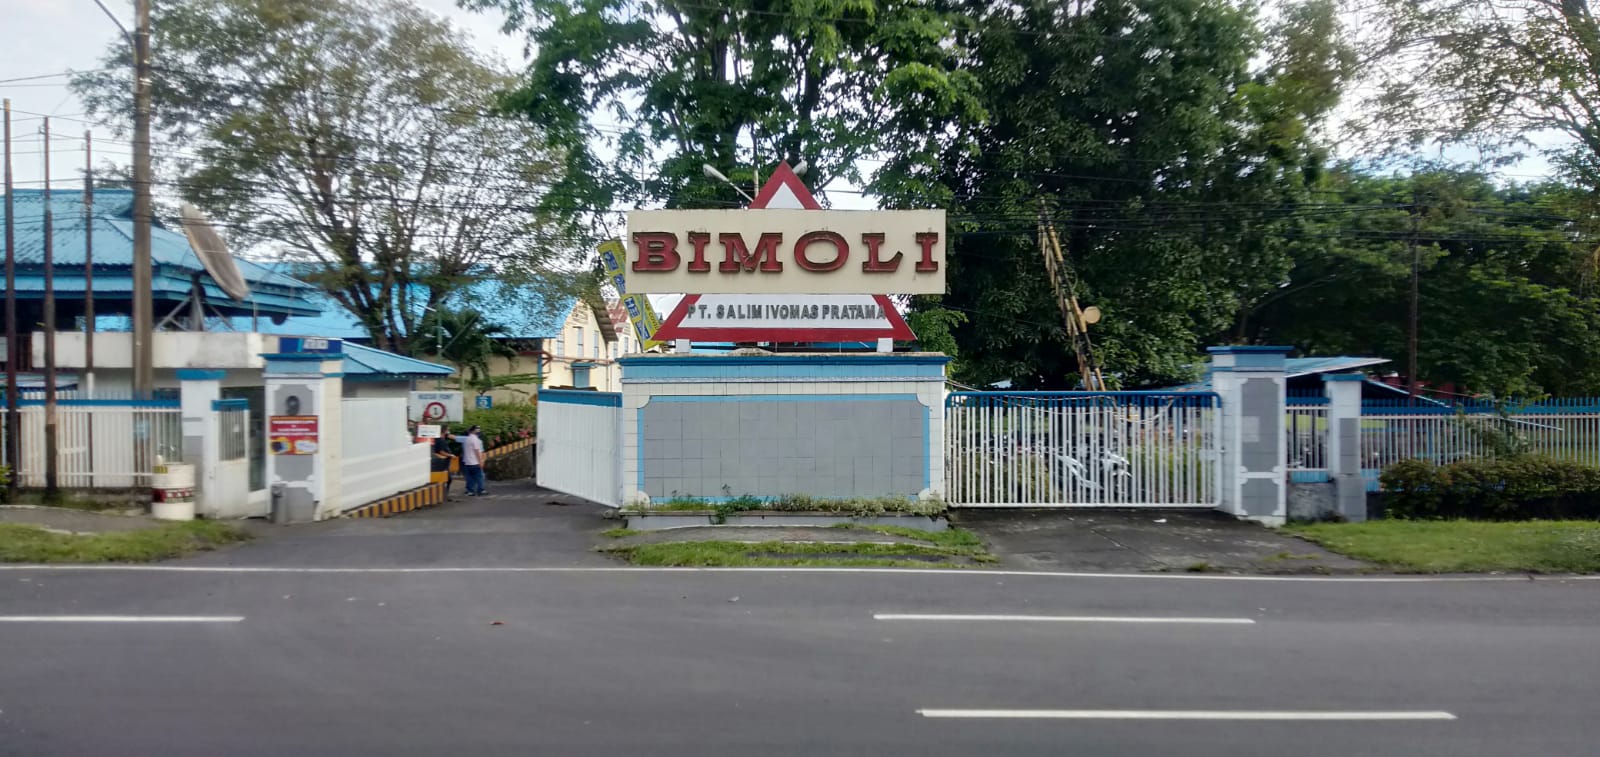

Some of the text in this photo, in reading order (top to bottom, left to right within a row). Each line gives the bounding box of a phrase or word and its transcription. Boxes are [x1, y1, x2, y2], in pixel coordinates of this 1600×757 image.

[632, 230, 939, 273] BIMOLI
[687, 303, 886, 320] PT. SALIM IVOMAS PRATAMA
